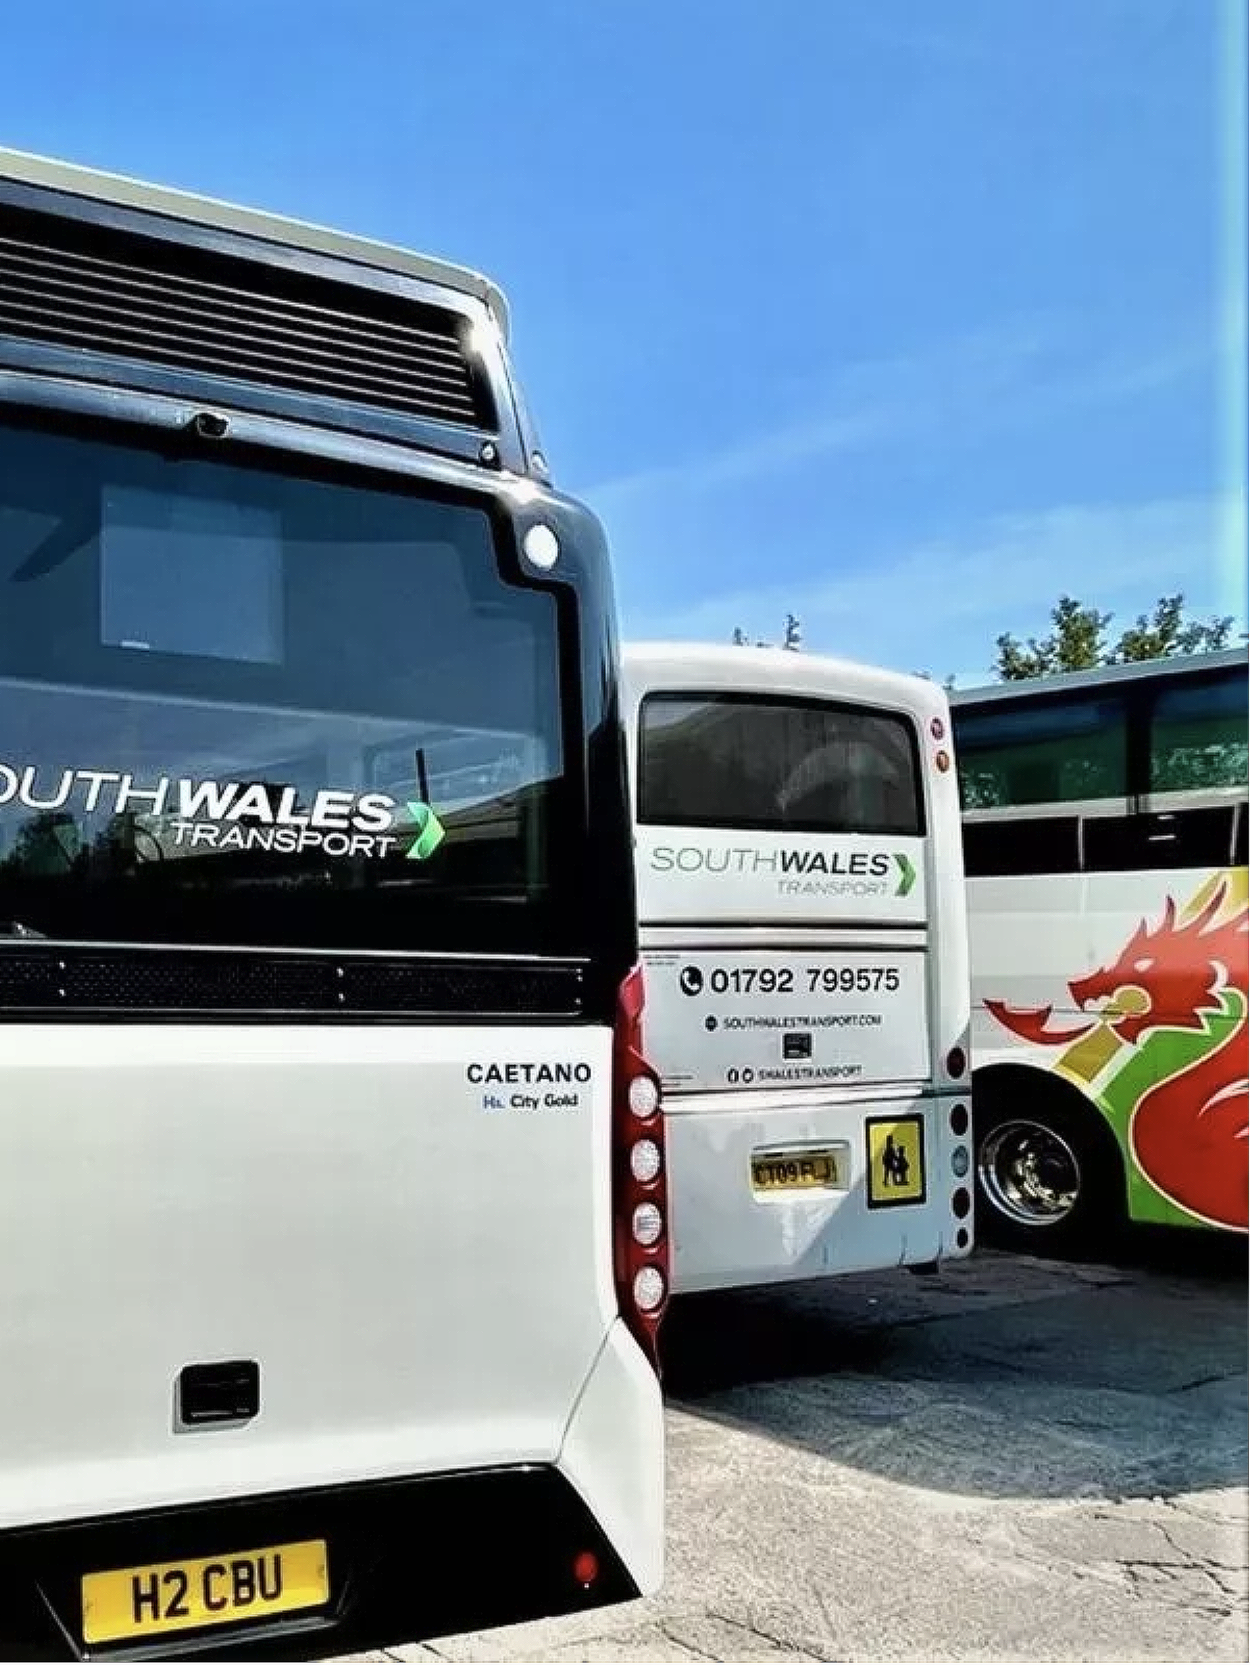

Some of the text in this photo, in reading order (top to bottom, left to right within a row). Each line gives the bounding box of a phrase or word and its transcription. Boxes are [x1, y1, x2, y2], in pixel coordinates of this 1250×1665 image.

[171, 821, 397, 860] TRANSPORT
[777, 880, 889, 897] TRANSPORT
[711, 967, 900, 993] 01792 799575
[723, 1014, 882, 1030] SOUTHWALESTRANSPORT.COM
[467, 1062, 592, 1084] CAETANO
[510, 1093, 540, 1110] City
[544, 1093, 579, 1107] Gold
[131, 1553, 283, 1624] H2 CBU
